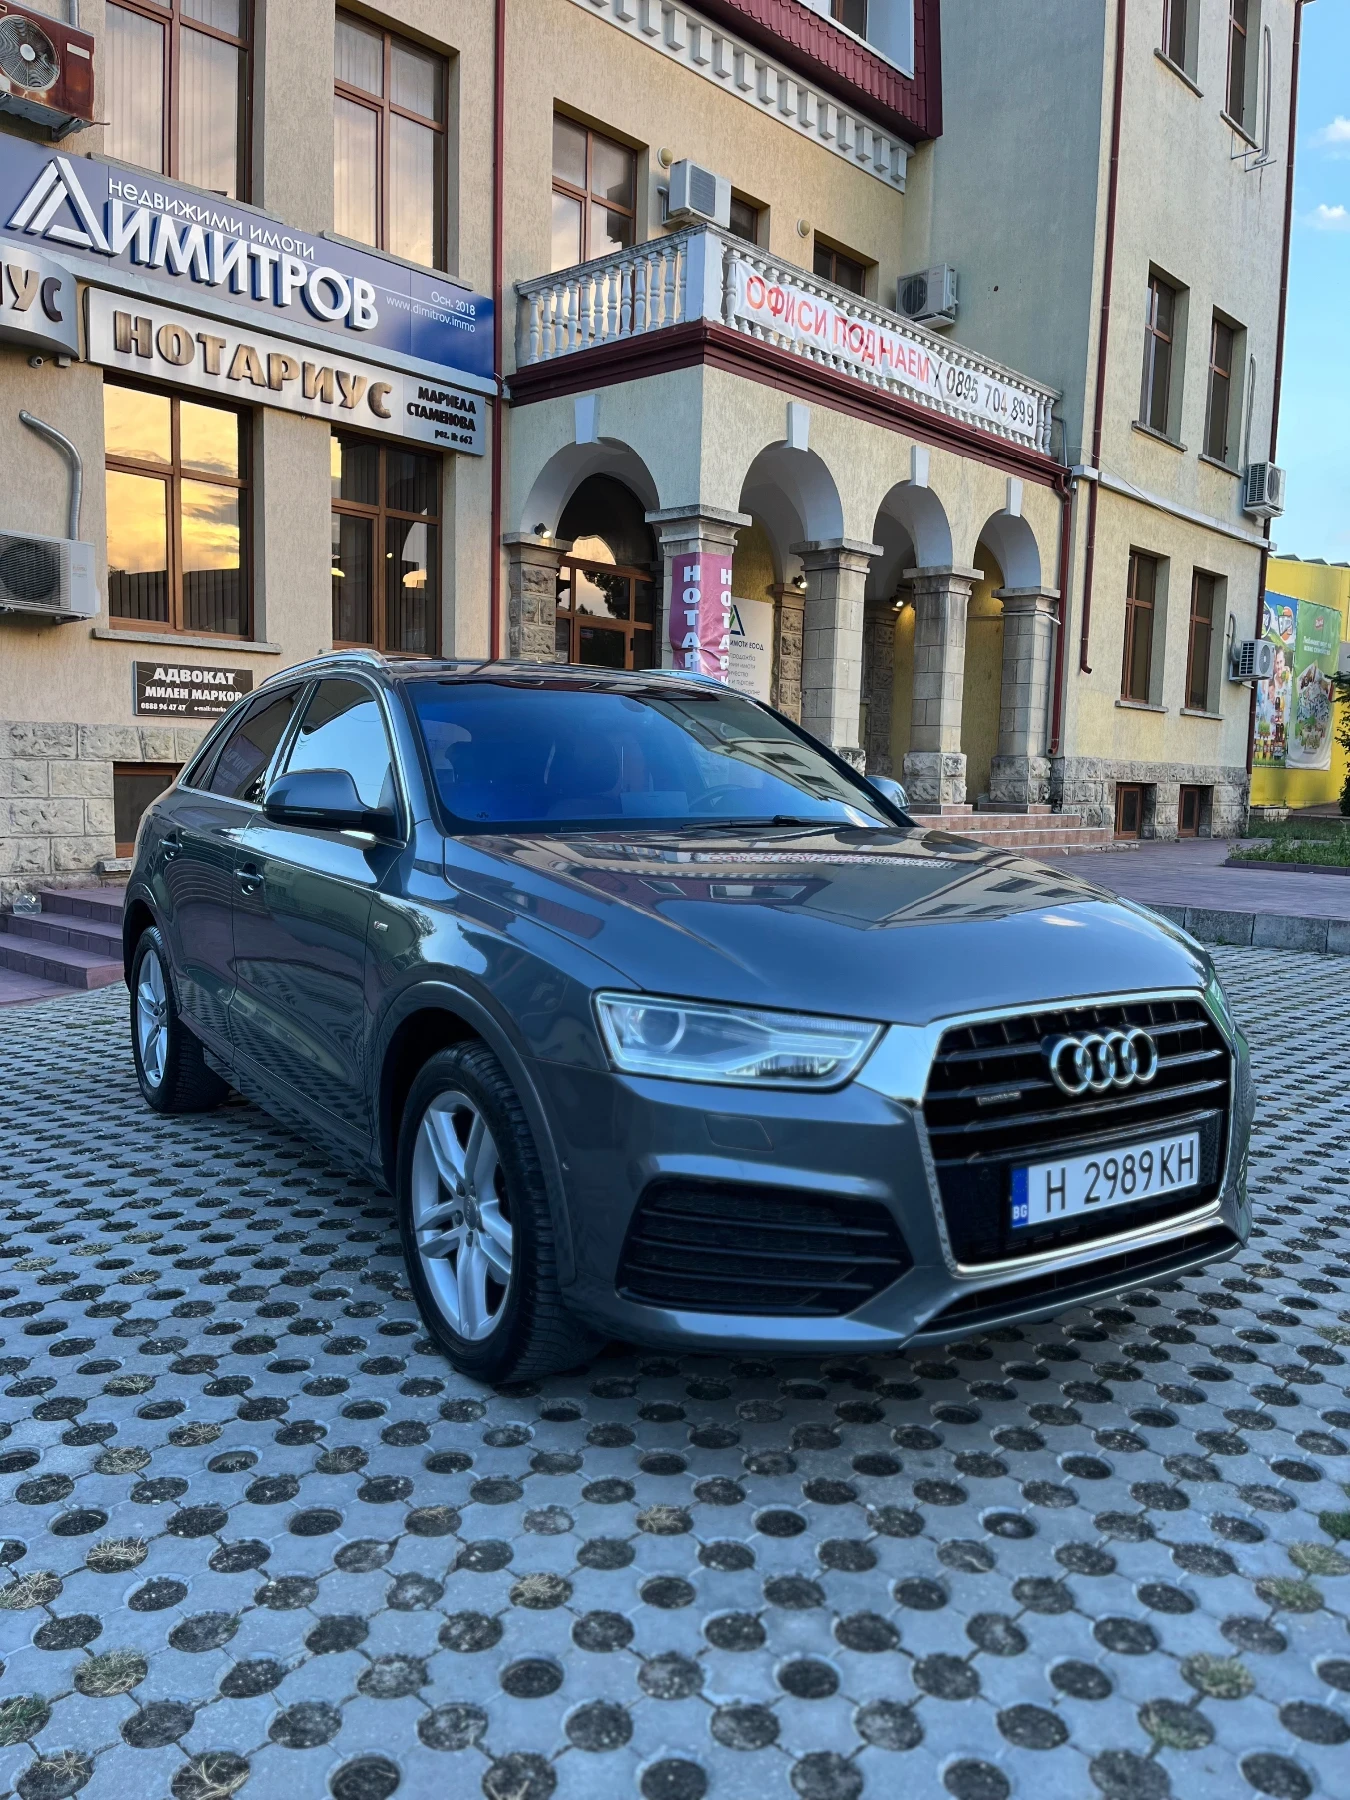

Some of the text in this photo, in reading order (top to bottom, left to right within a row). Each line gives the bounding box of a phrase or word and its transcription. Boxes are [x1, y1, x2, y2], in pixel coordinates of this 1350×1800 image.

[0, 261, 63, 322] УС
[386, 296, 476, 333] www.dimitrov.immo
[455, 299, 476, 316] 2018
[113, 310, 393, 419] НОТАРИУС
[746, 275, 827, 339] ОФИСИ
[946, 366, 979, 404] 0895
[984, 383, 1008, 417] 704
[1010, 396, 1034, 427] 899
[417, 386, 477, 414] МАРИЕЛА
[406, 402, 476, 432] СТАМЕНОВА
[459, 434, 473, 445] 662
[153, 667, 235, 685] АДВОКАТ
[145, 686, 189, 699] МИЛЕН
[140, 702, 158, 710] 0888
[159, 703, 168, 711] 96
[168, 703, 177, 711] 47
[178, 704, 186, 712] 47
[1046, 1166, 1067, 1214] H
[1012, 1204, 1028, 1220] BG
